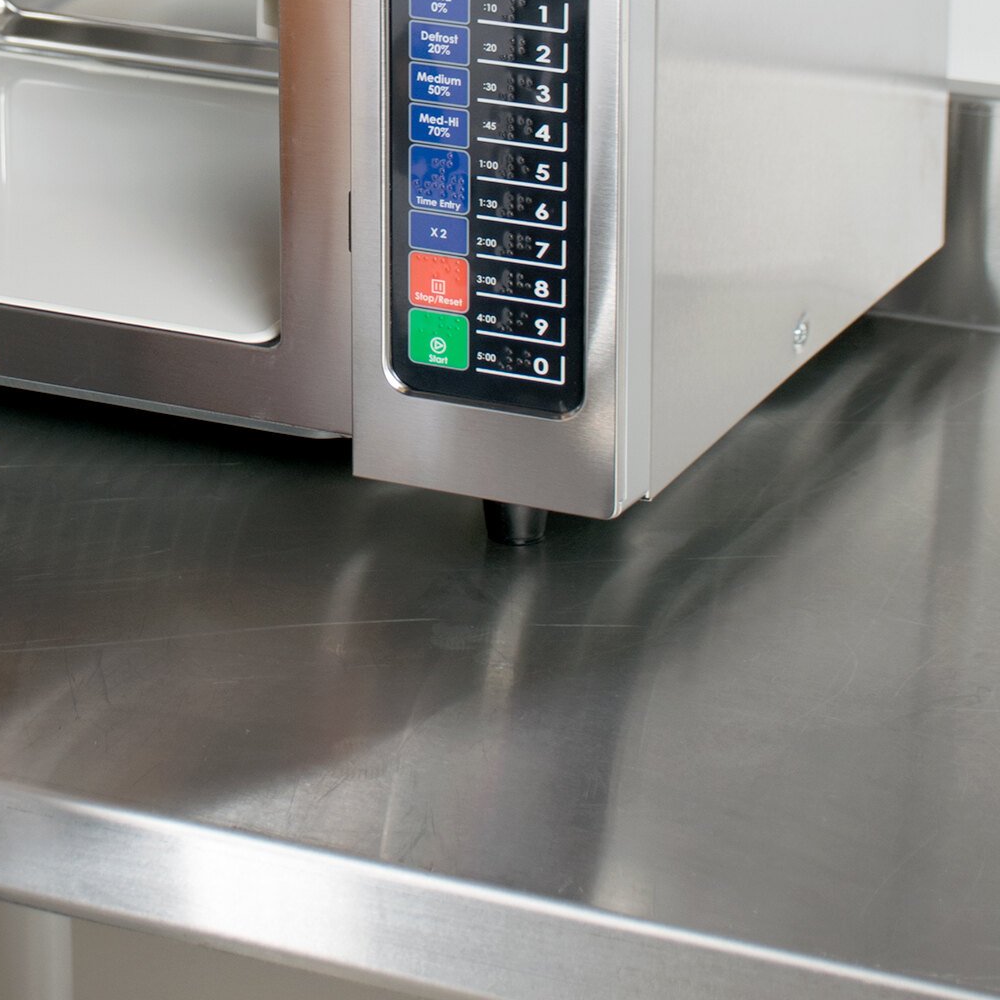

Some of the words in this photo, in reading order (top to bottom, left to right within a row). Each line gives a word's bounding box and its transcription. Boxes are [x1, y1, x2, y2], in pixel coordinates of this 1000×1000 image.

[430, 2, 448, 14] 0%
[483, 3, 498, 12] :10
[538, 5, 548, 23] 1
[420, 30, 458, 44] Defrost
[427, 44, 451, 56] 20%
[483, 43, 498, 52] :20
[535, 45, 551, 64] 2
[416, 71, 462, 86] Medium
[427, 85, 451, 97] 50%
[483, 82, 497, 92] :30
[535, 85, 551, 103] 3
[419, 112, 459, 127] Med-Hi
[482, 121, 497, 130] :45
[427, 125, 451, 138] 70%
[535, 124, 551, 143] 4
[479, 160, 499, 170] 1:00
[535, 163, 550, 182] 5
[415, 196, 437, 207] Time
[439, 200, 462, 212] Entry
[478, 198, 498, 209] 1:30
[535, 203, 550, 221] 6
[430, 227, 439, 238] X
[439, 228, 447, 239] 2
[476, 237, 497, 248] 2:00
[535, 241, 550, 259] 7
[476, 275, 497, 286] 3:00
[533, 280, 550, 298] 8
[414, 291, 463, 307] Stop/Reset
[476, 313, 497, 324] 4:00
[534, 318, 549, 336] 9
[428, 354, 448, 365] Start
[476, 352, 497, 363] 5:00
[533, 357, 549, 375] 0
